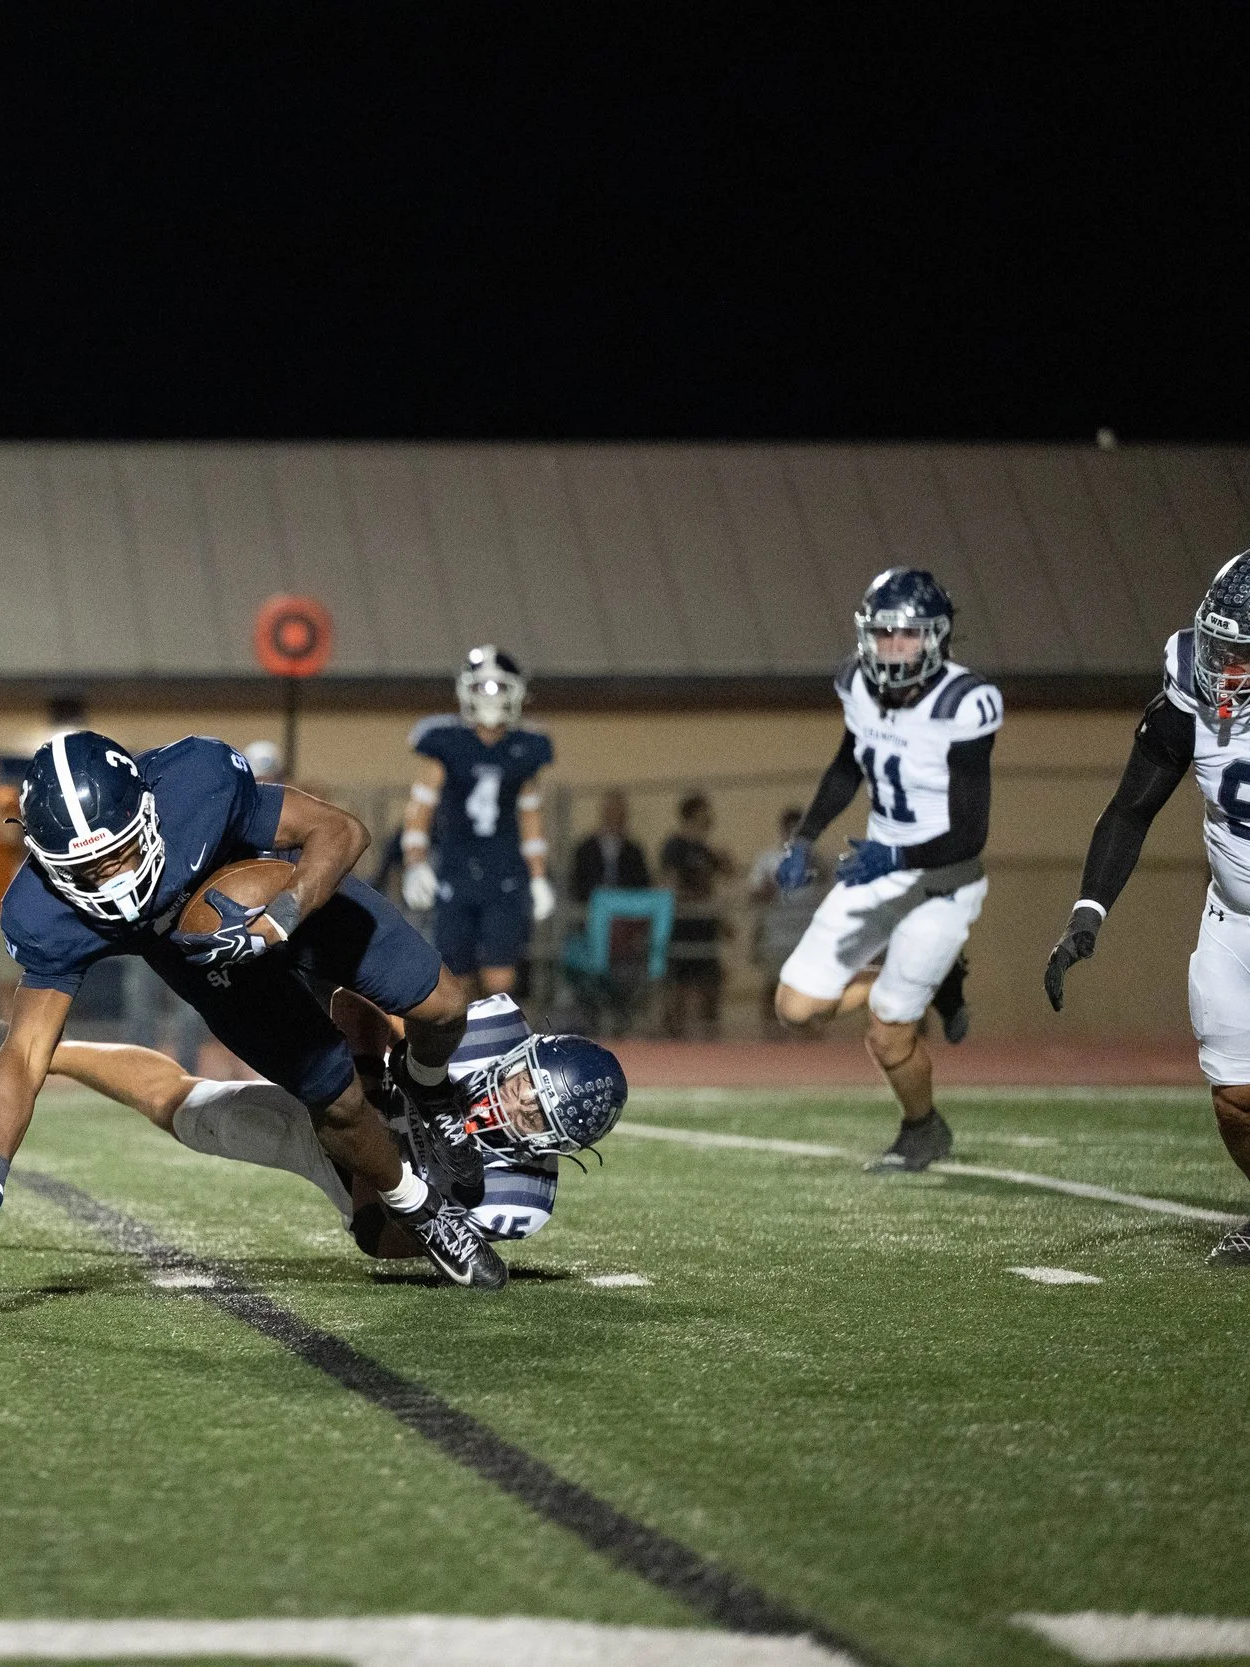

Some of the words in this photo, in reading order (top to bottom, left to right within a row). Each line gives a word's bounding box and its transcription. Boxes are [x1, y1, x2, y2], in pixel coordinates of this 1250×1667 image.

[976, 694, 997, 728] 11
[105, 750, 139, 778] 3
[861, 747, 917, 823] 11
[466, 771, 501, 836] 4
[72, 832, 106, 849] Riddell
